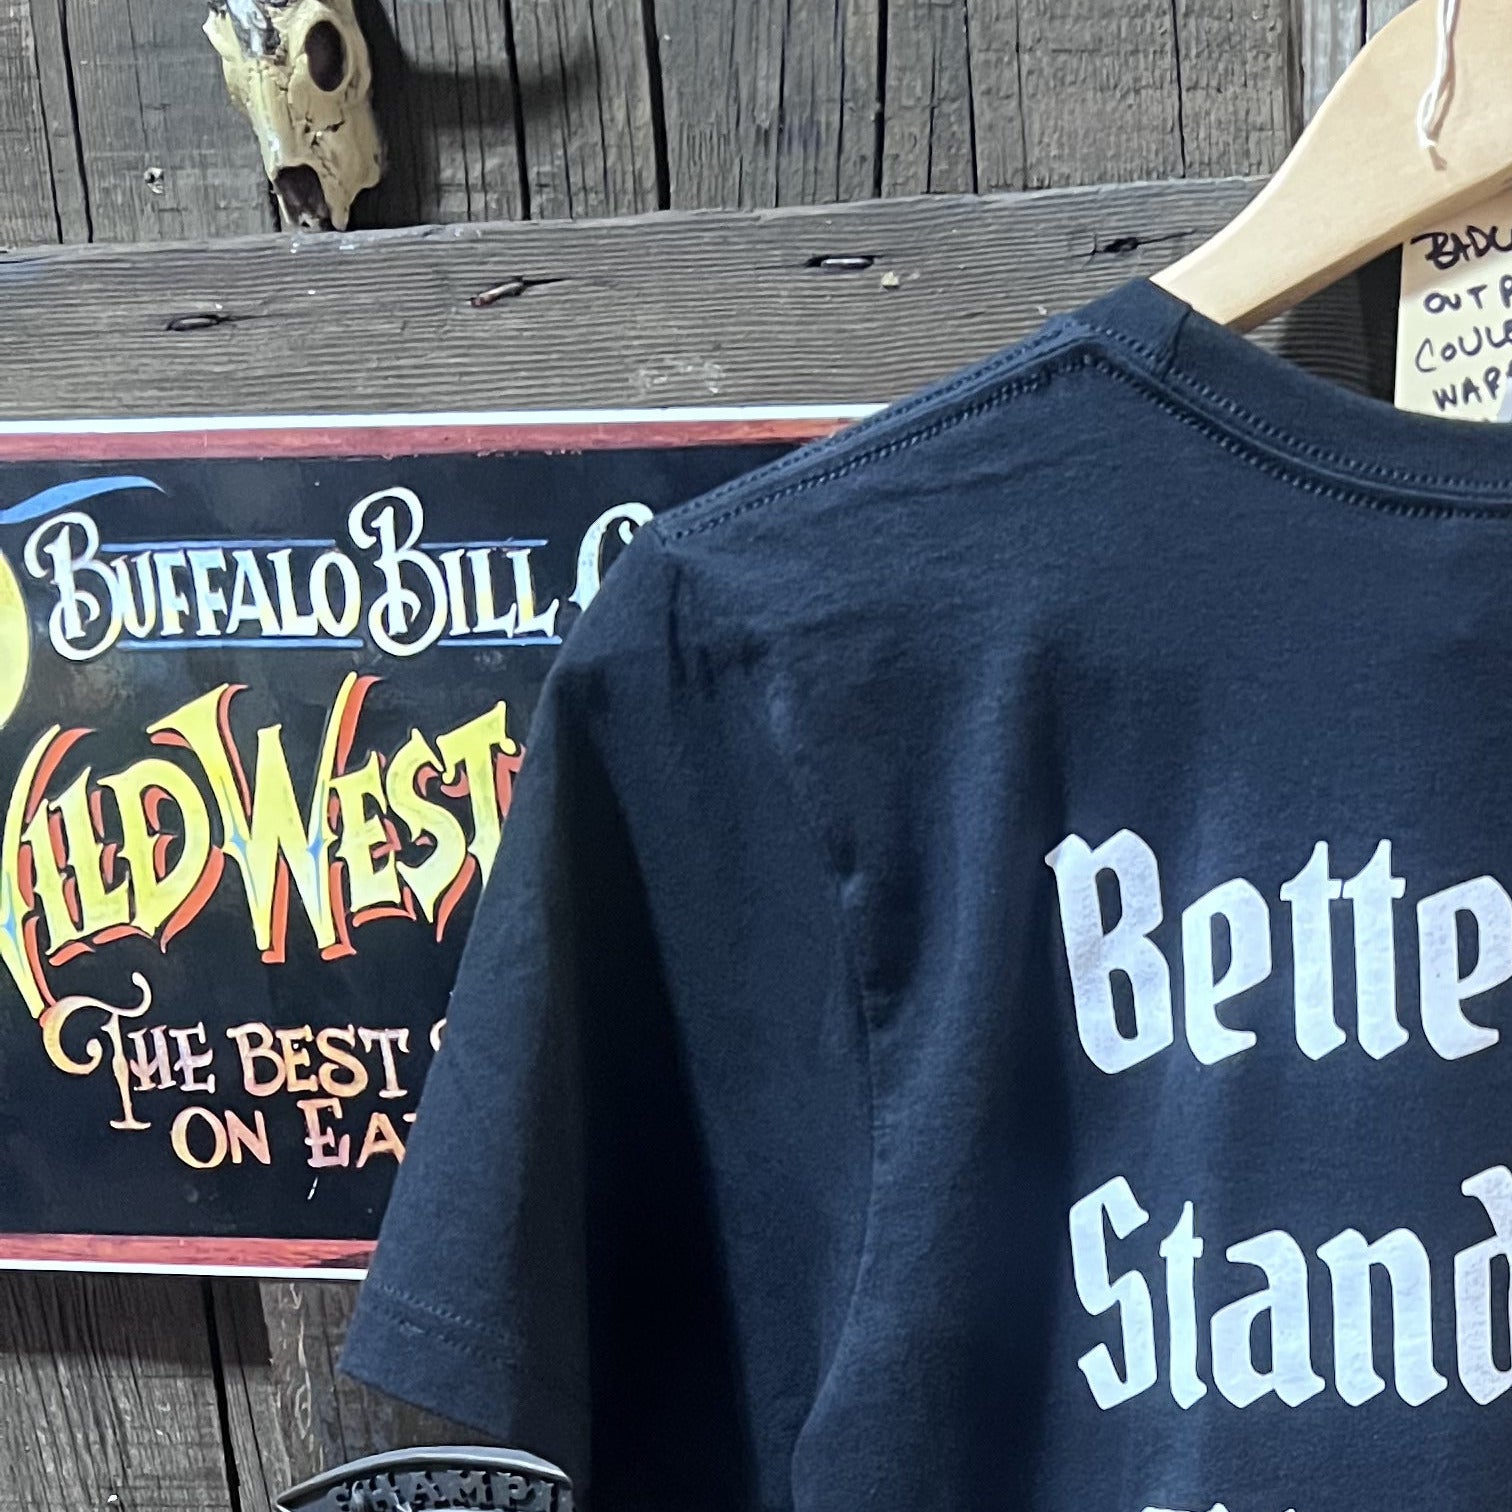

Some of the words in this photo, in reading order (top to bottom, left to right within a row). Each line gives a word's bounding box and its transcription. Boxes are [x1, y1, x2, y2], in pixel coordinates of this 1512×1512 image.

[24, 511, 363, 662] BUFFALO
[348, 486, 560, 656] BILL
[41, 972, 216, 1131] THE
[229, 1020, 411, 1101] BEST
[171, 1107, 272, 1170] ON
[297, 1096, 416, 1170] EA
